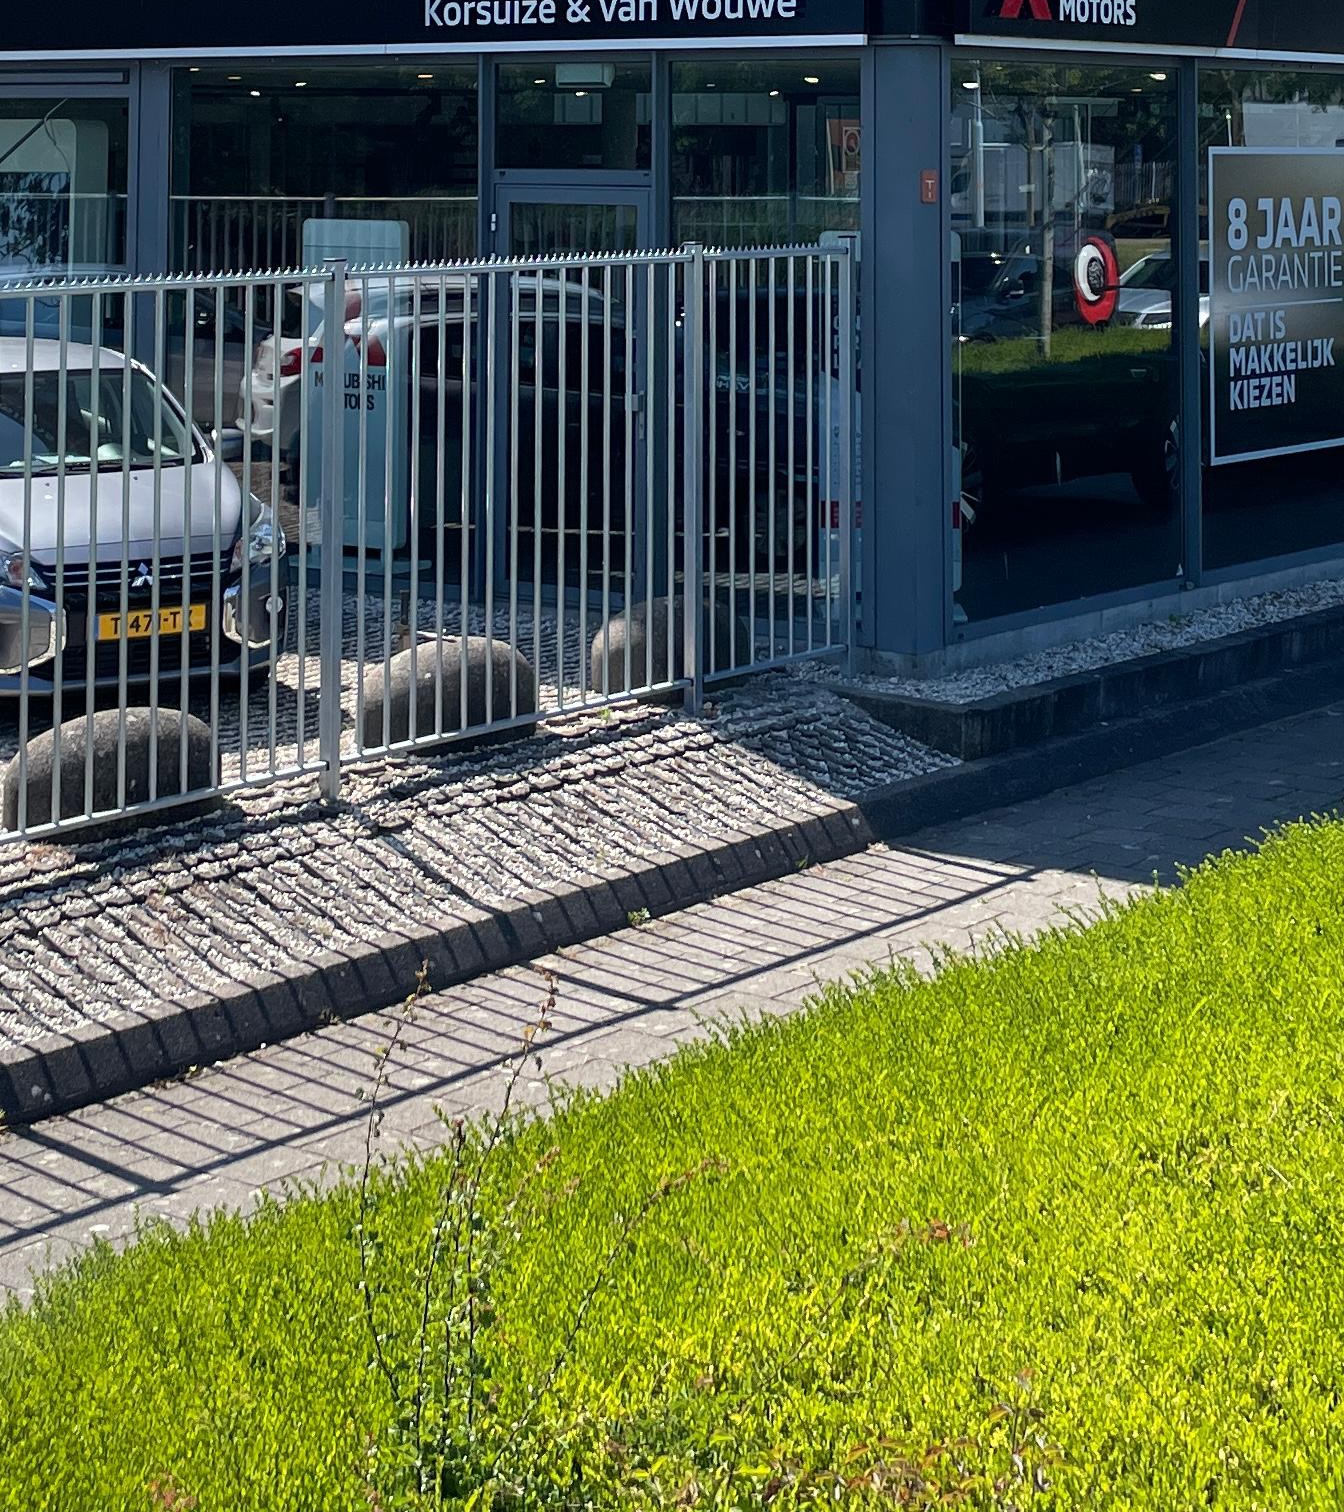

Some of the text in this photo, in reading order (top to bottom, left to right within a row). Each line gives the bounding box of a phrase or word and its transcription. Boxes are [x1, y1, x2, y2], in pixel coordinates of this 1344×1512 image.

[1227, 195, 1343, 251] 8 JAAR
[1227, 250, 1344, 294] GARANTIE
[1229, 310, 1286, 344] DAT IS
[1229, 337, 1336, 378] MAKKELIJK
[1229, 374, 1297, 412] KIEZEN
